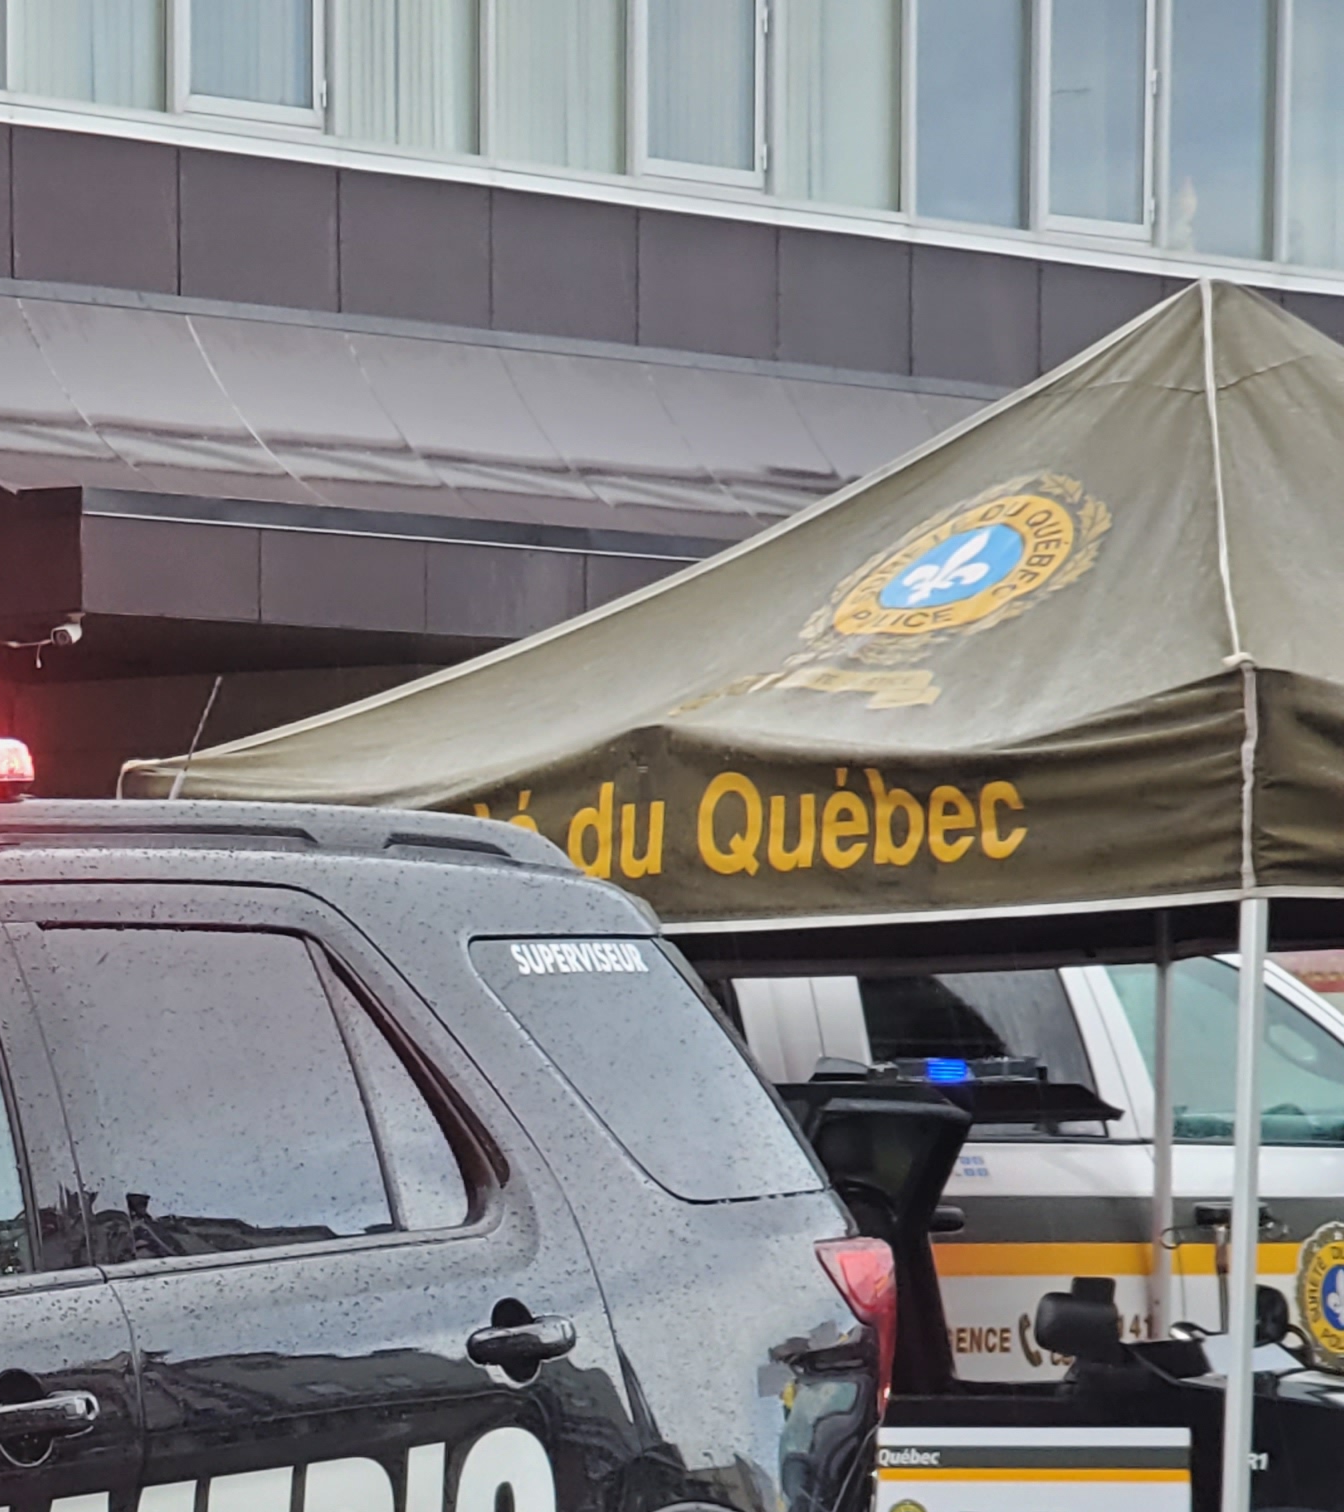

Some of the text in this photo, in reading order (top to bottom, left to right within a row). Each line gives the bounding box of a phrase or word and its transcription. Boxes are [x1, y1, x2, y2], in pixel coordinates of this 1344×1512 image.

[567, 781, 665, 879] du
[697, 767, 1028, 877] Québec
[510, 943, 649, 976] SUPERVISEUR
[877, 1447, 941, 1468] Québec
